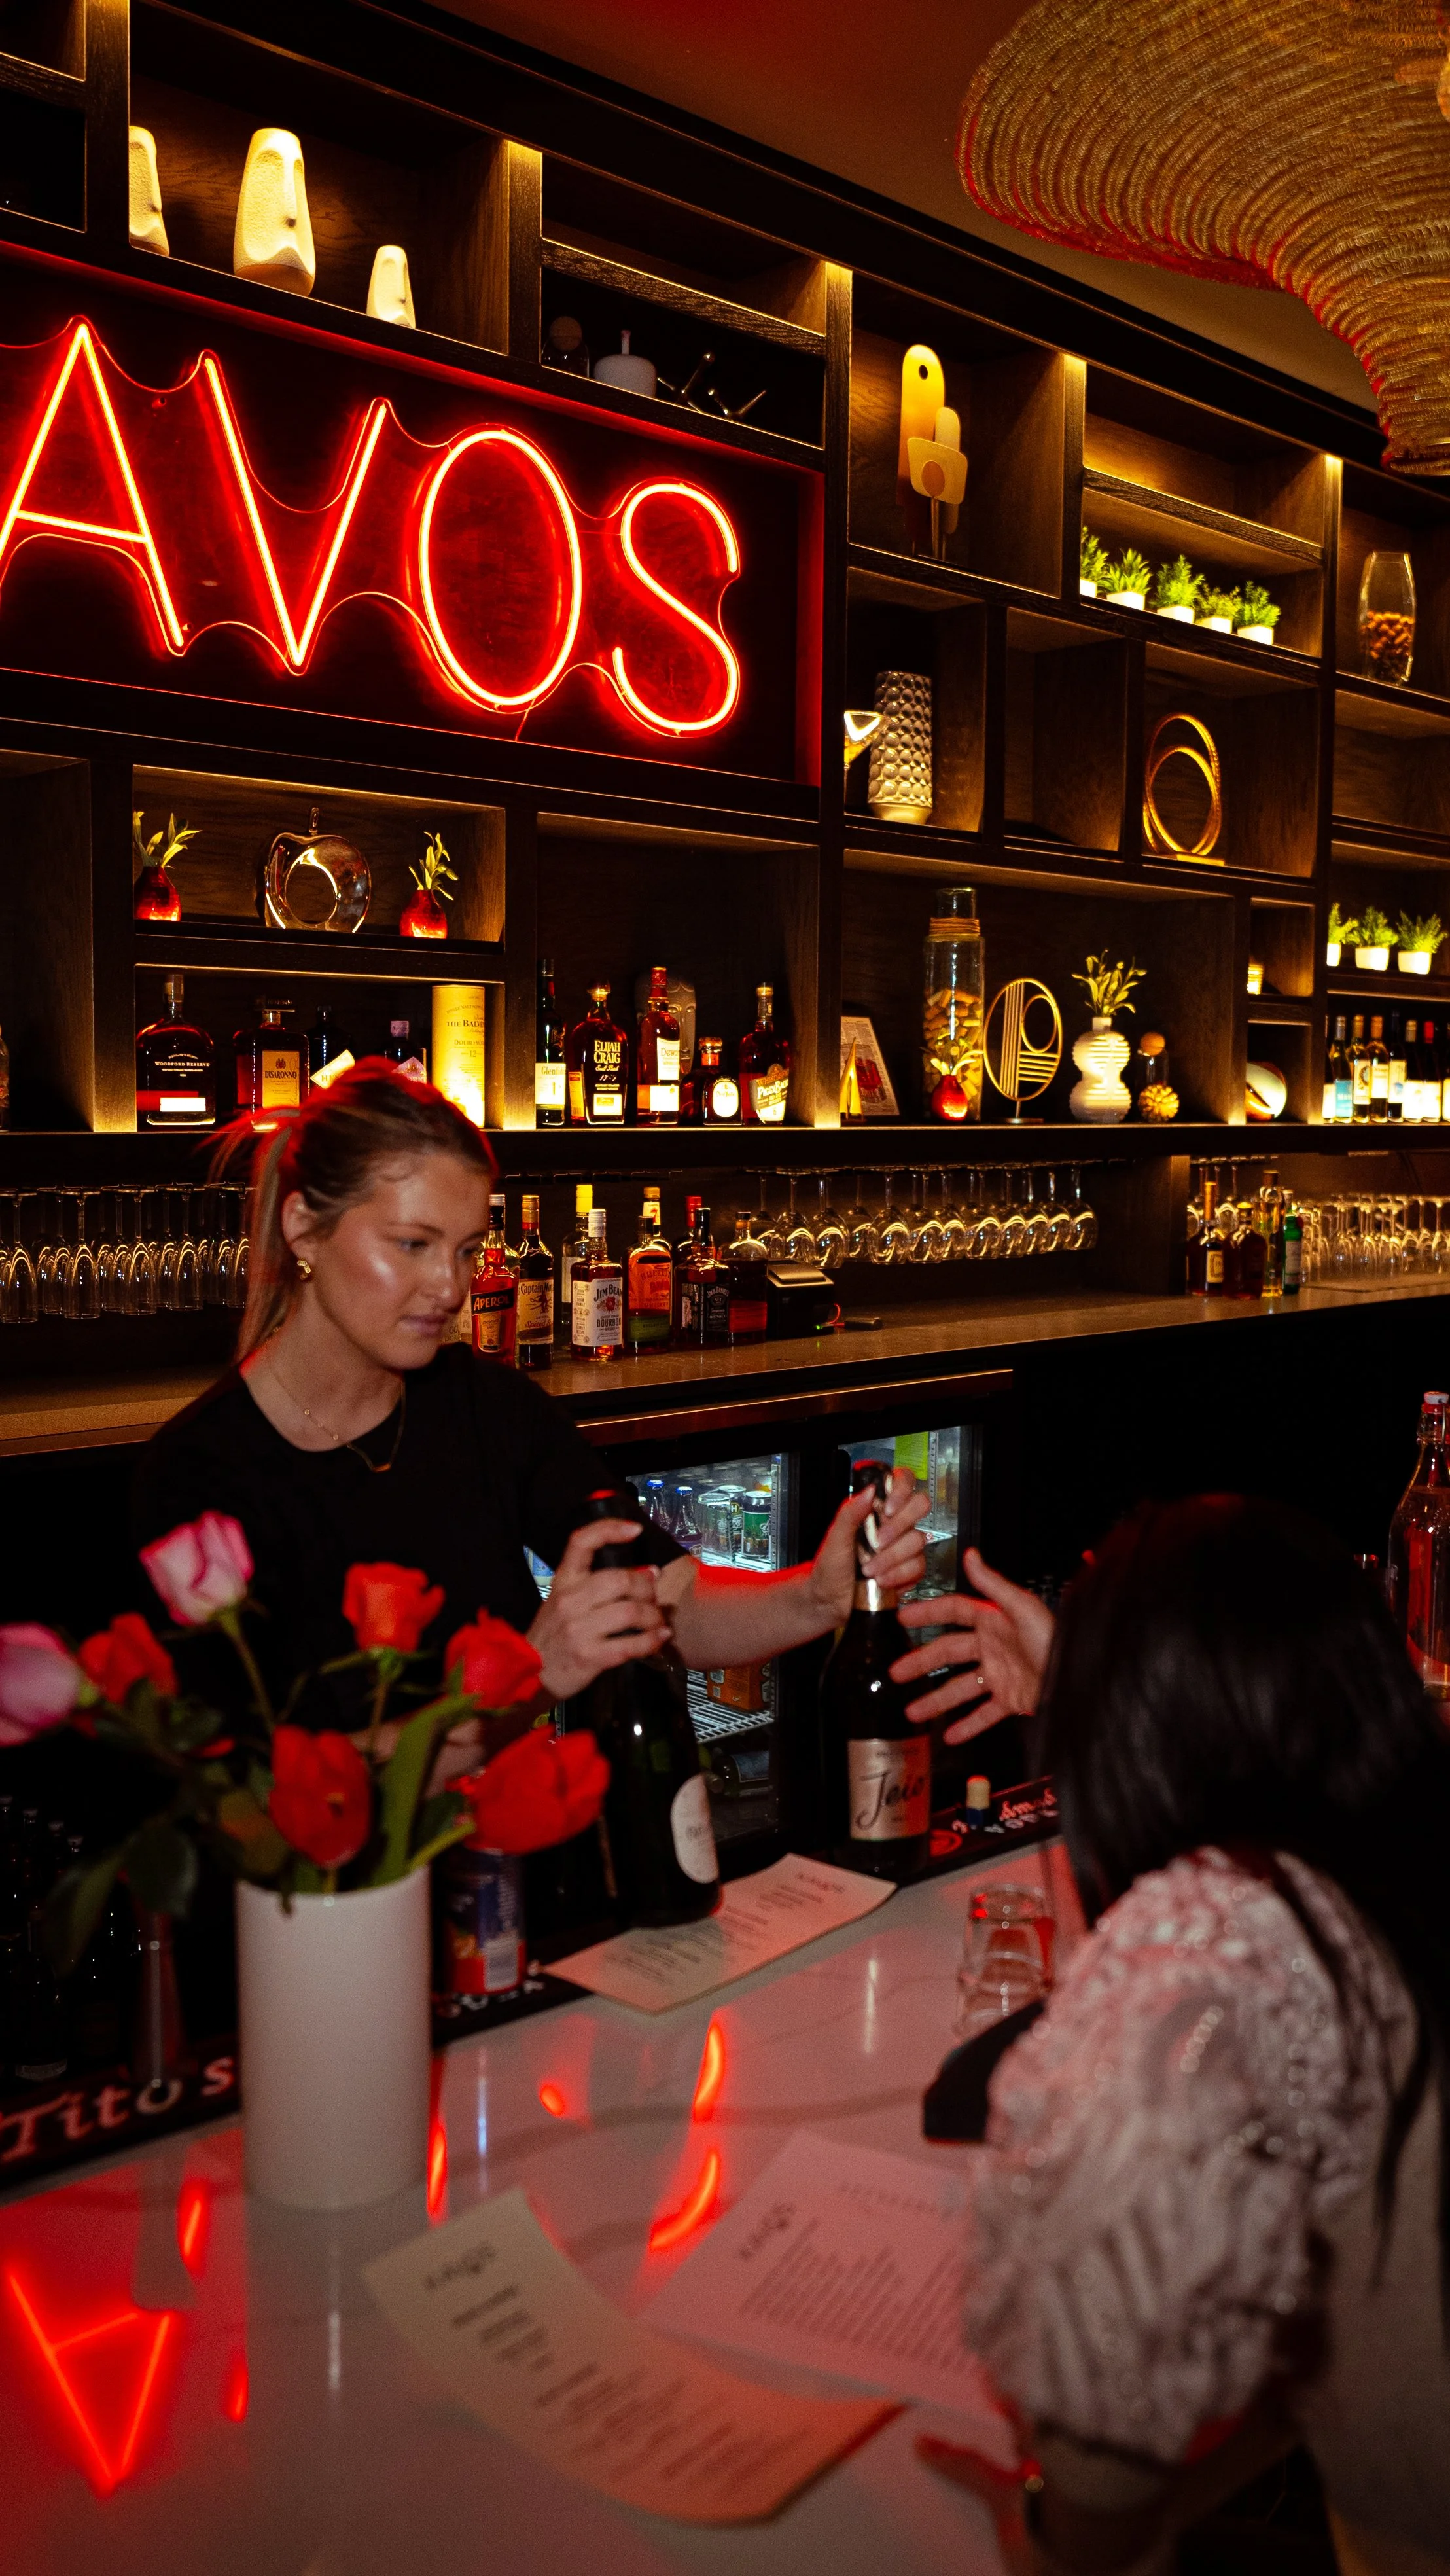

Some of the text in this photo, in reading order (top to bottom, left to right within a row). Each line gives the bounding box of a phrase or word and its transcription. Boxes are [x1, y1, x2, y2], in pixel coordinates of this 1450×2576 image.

[0, 319, 741, 734] AVOS
[594, 1040, 621, 1053] ELIJAH
[593, 1051, 620, 1065] CRAIG
[264, 1070, 297, 1079] DISARONNO
[520, 1283, 543, 1295] Captain
[593, 1286, 608, 1302] JIM
[474, 1296, 510, 1311] APEROL
[596, 1317, 621, 1328] BOURBON
